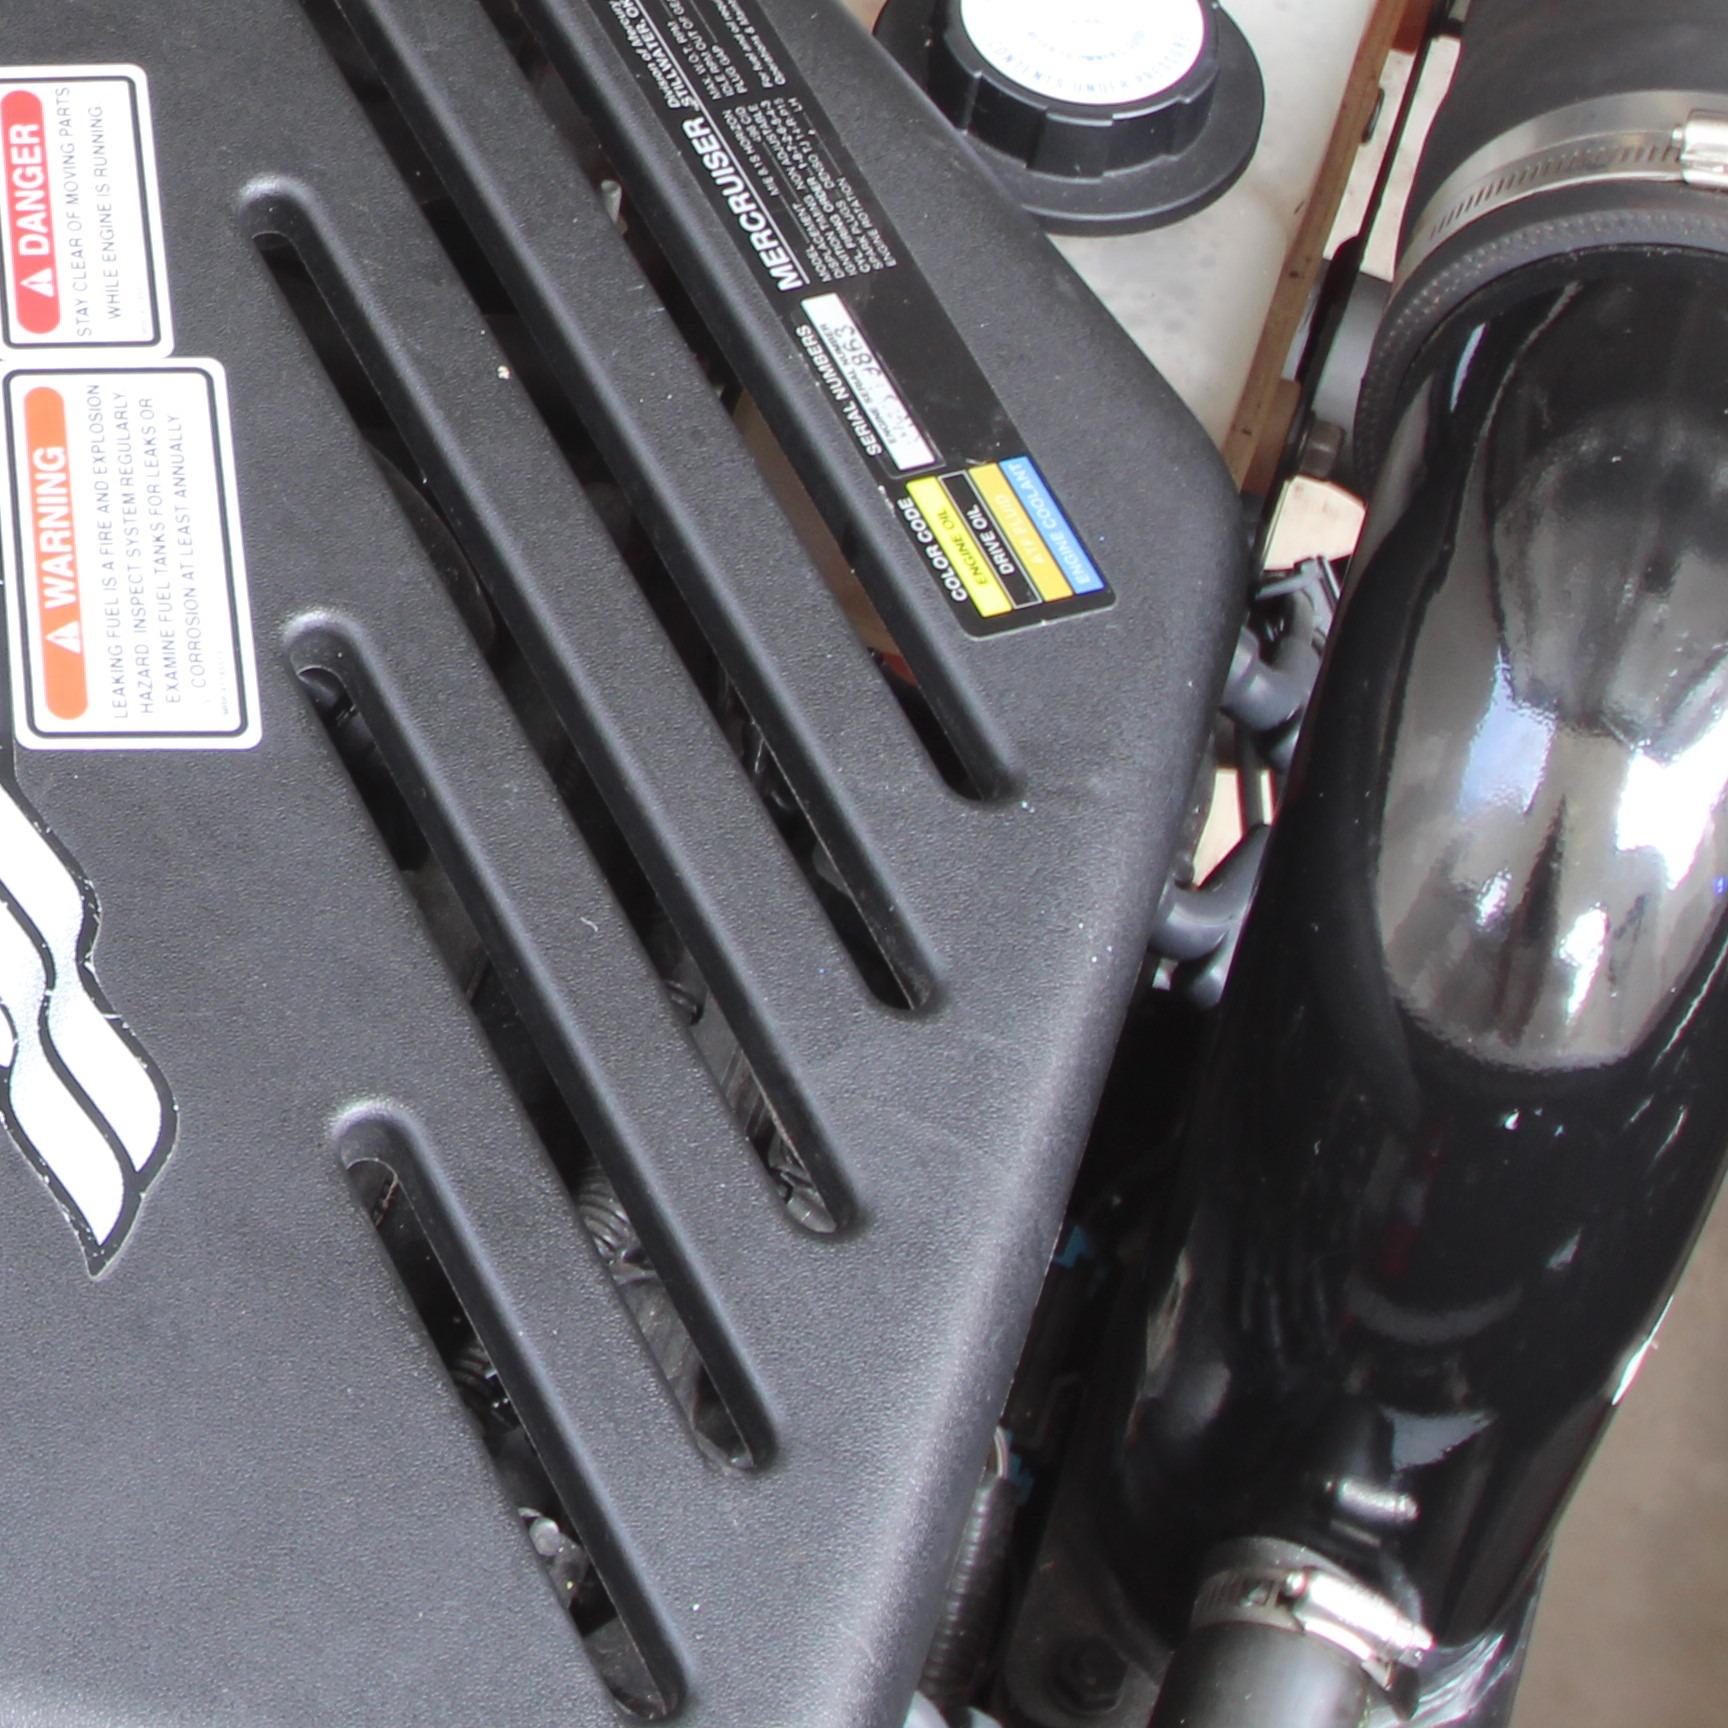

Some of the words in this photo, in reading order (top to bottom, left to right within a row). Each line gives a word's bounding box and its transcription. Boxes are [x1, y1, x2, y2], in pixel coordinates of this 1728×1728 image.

[606, 0, 645, 47] Mercury
[665, 20, 689, 43] RPM
[686, 29, 708, 50] OUT
[635, 47, 653, 61] of
[710, 43, 733, 65] GAP
[645, 63, 682, 108] Division
[713, 73, 735, 96] IDLE
[723, 65, 749, 93] PLUG
[54, 86, 73, 136] PARTS
[785, 96, 804, 112] LH
[87, 105, 108, 175] RUNNING
[719, 108, 757, 155] HORIZON
[746, 103, 793, 166] ADJUSTABLE
[8, 122, 50, 256] DANGER
[59, 143, 80, 204] MOVING
[94, 183, 110, 196] IS
[784, 166, 807, 190] NON
[804, 175, 836, 212] ORDER
[805, 153, 836, 189] DENSO
[65, 211, 82, 231] OF
[678, 116, 804, 291] MERCRUISER
[801, 194, 831, 230] TIMING
[833, 199, 864, 234] PLUGS
[834, 176, 874, 228] ROTATION
[96, 203, 116, 261] ENGINE
[791, 202, 846, 278] DISPLACEMENT
[823, 230, 859, 276] IGNITION
[827, 213, 857, 248] FIRING
[855, 234, 885, 270] SPARK
[866, 228, 898, 267] ENGINE
[68, 237, 88, 291] CLEAR
[801, 244, 834, 281] MODEL
[72, 296, 92, 336] STAY
[102, 269, 122, 319] WHILE
[792, 323, 851, 401] NUMBERS
[818, 322, 851, 366] NUMBER
[845, 368, 873, 403] SERIAL
[85, 384, 108, 474] EXPLOSION
[138, 397, 155, 420] OR
[839, 401, 883, 455] SERIAL
[867, 405, 897, 443] ENGINE
[112, 391, 135, 486] REGULARLY
[141, 425, 160, 476] LEAKS
[165, 411, 188, 498] ANNUALLY
[93, 480, 111, 513] AND
[146, 483, 164, 515] FOR
[962, 503, 990, 530] OIL
[992, 492, 1029, 535] FLUID
[1006, 460, 1060, 530] COOLANT
[32, 445, 78, 609] WARNING
[96, 519, 115, 555] FIRE
[120, 491, 140, 557] SYSTEM
[173, 504, 194, 556] LEAST
[895, 496, 935, 543] CODE
[933, 507, 956, 530] OIL
[99, 559, 116, 570] A
[149, 521, 169, 574] TANKS
[179, 561, 197, 579] AT
[949, 533, 989, 585] ENGINE
[977, 529, 1017, 575] DRIVE
[1048, 530, 1093, 584] ENGINE
[101, 576, 118, 590] IS
[923, 543, 970, 601] COLOR
[102, 597, 122, 638] FUEL
[126, 564, 147, 633] INSPECT
[155, 581, 174, 621] FUEL
[181, 586, 207, 688] CORROSION
[107, 644, 129, 719] LEAKING
[159, 628, 181, 703] EXAMINE
